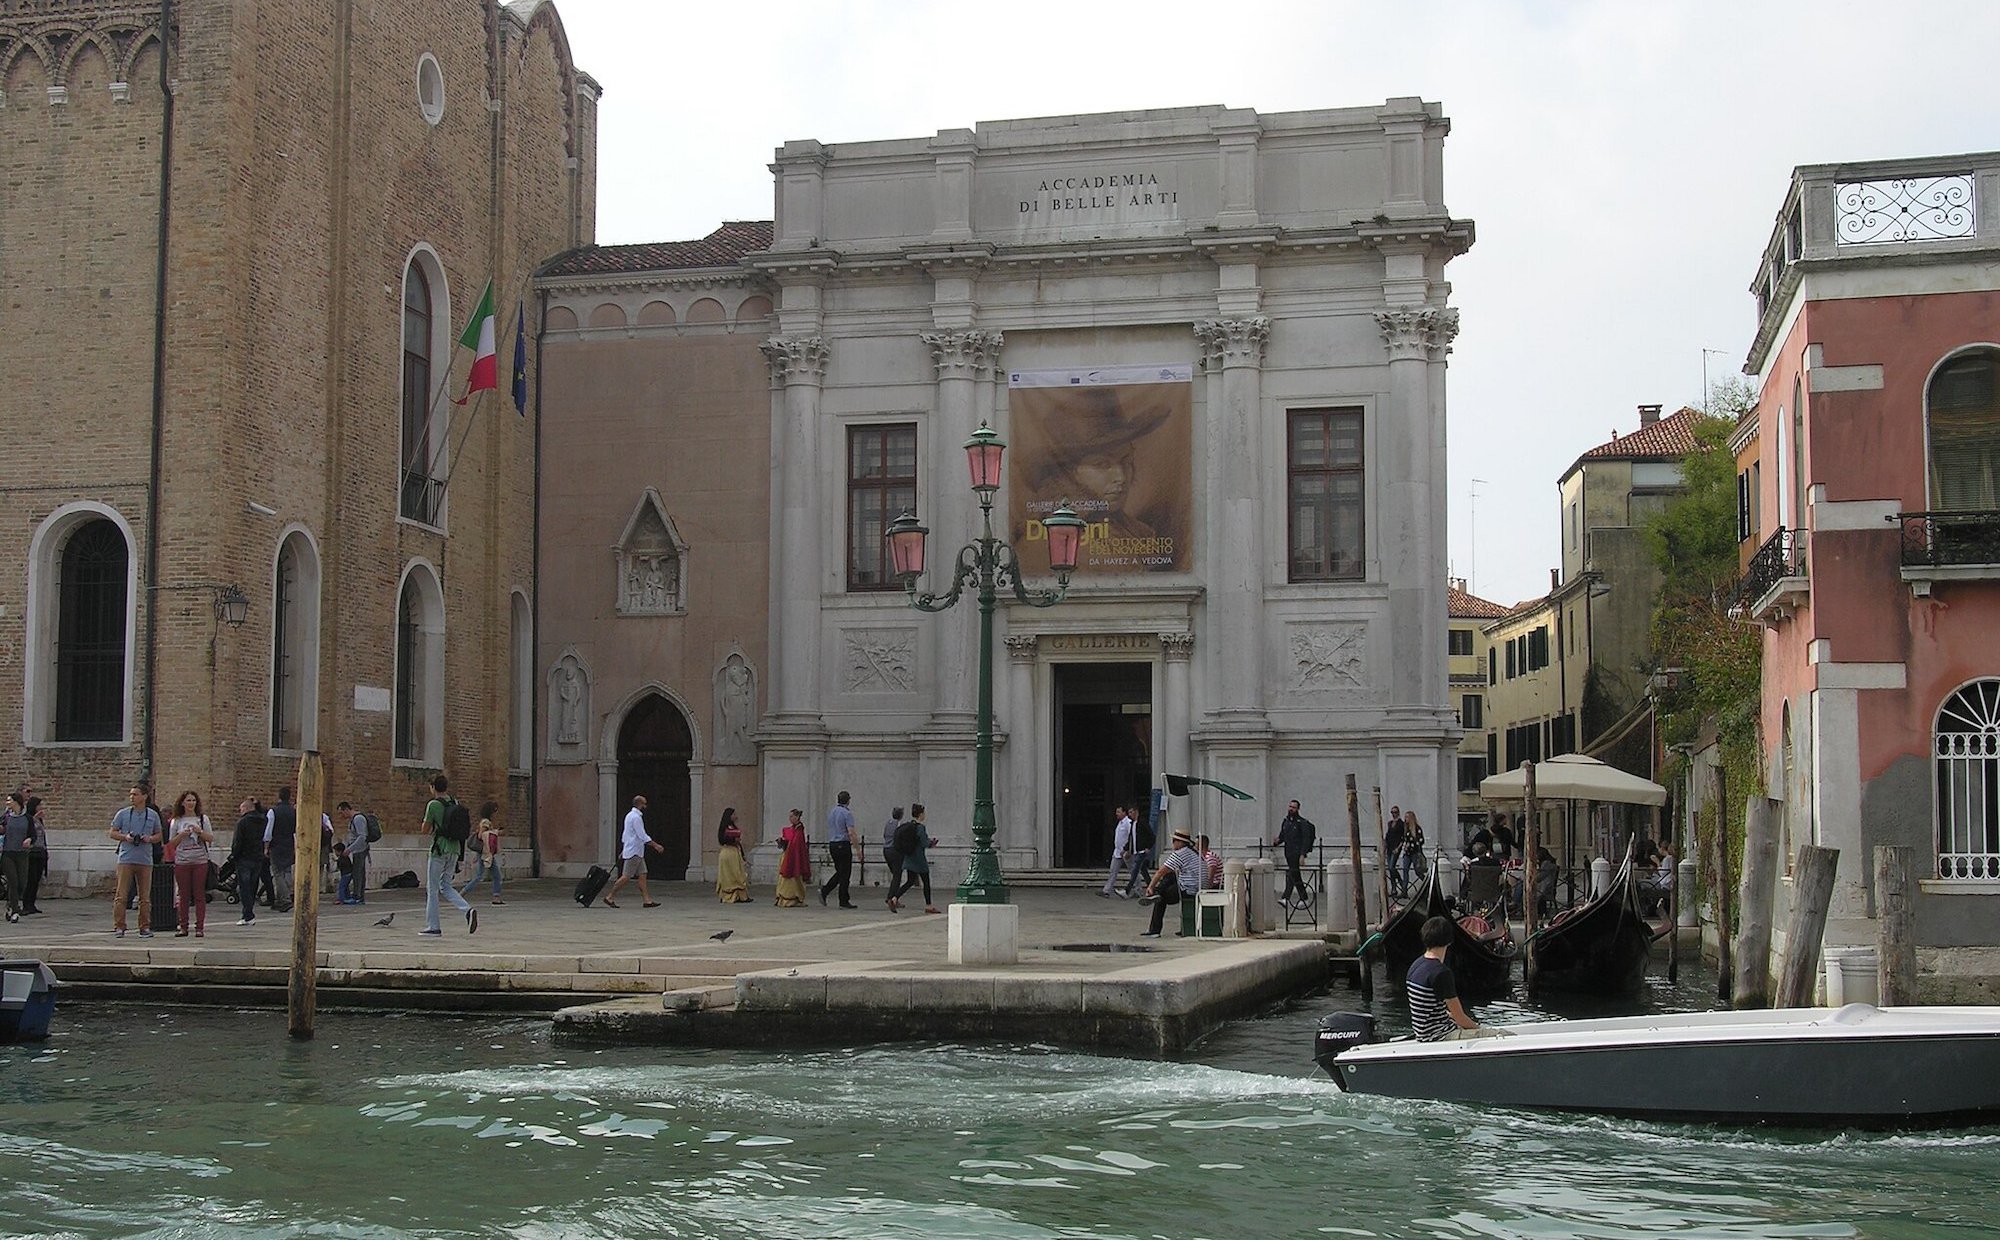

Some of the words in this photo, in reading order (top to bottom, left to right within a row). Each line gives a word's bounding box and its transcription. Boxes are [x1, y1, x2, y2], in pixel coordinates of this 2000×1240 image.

[1038, 173, 1158, 191] ACCADEMIA
[1019, 201, 1039, 213] DI
[1052, 196, 1115, 211] BELLE
[1129, 192, 1177, 206] ARTI
[1104, 557, 1129, 565] HAYEZ
[1142, 556, 1174, 565] VEDOVA
[1052, 635, 1150, 649] GALLERIE
[1319, 1031, 1361, 1040] MERCURY
